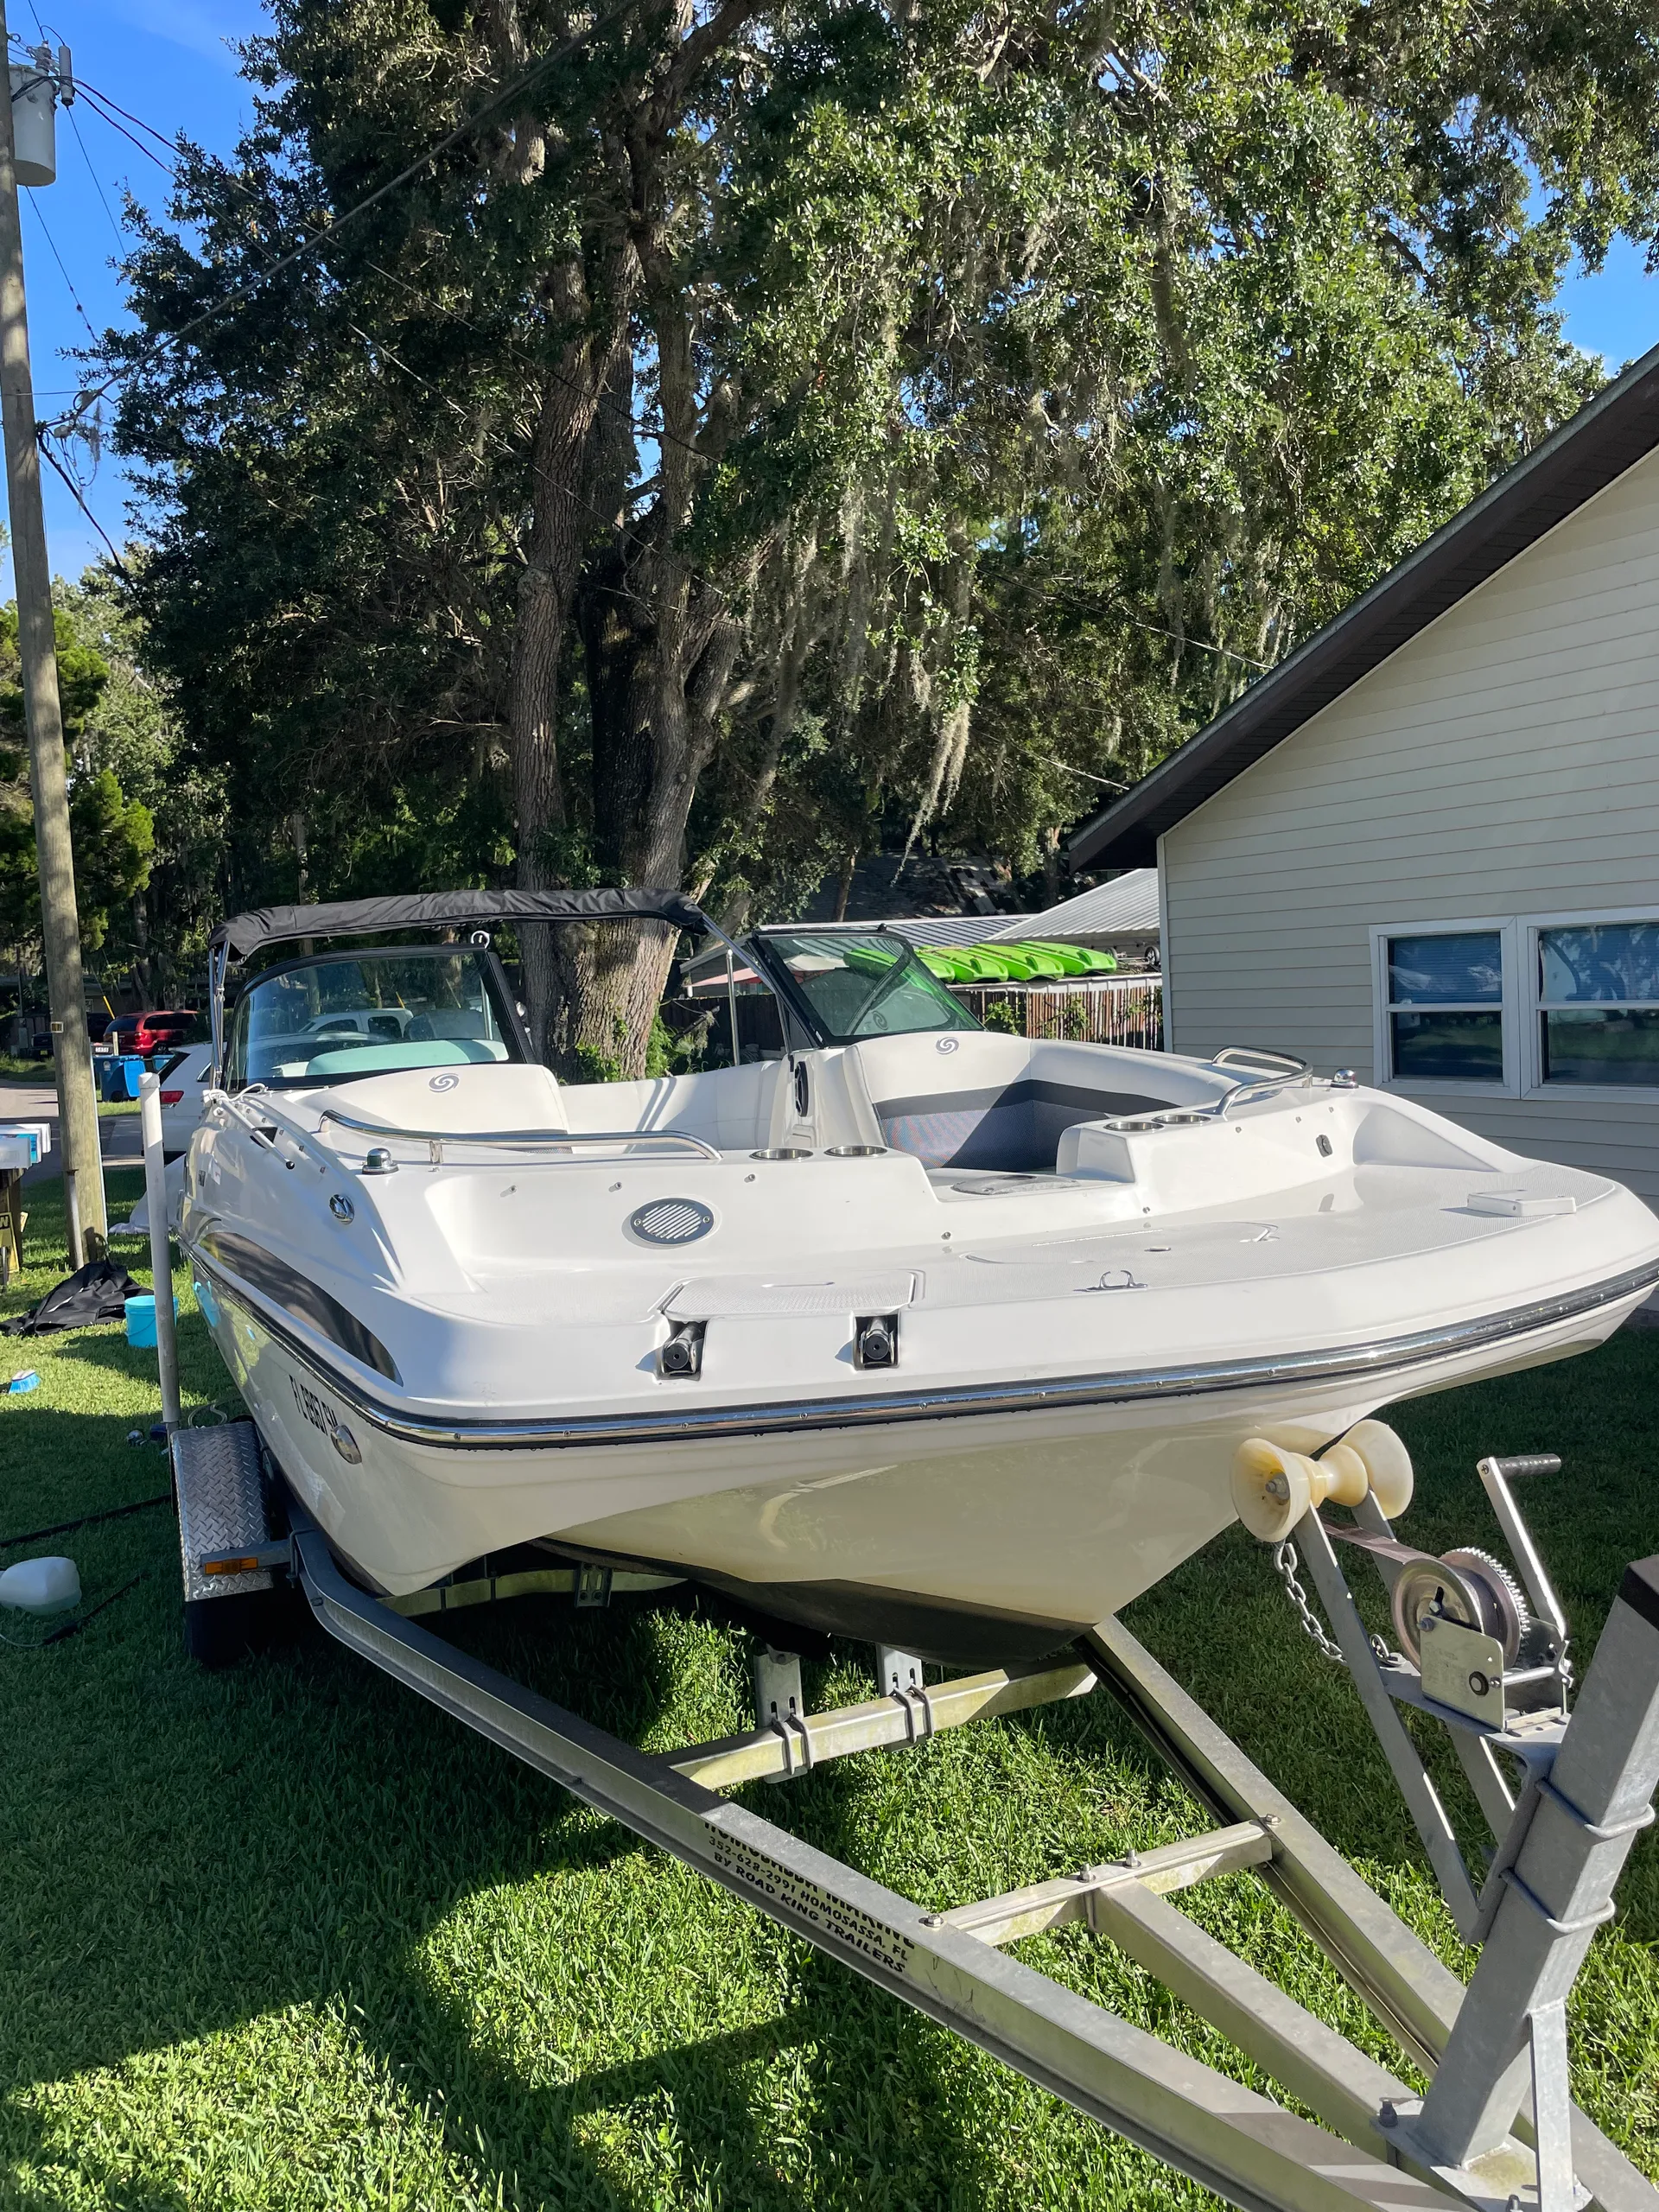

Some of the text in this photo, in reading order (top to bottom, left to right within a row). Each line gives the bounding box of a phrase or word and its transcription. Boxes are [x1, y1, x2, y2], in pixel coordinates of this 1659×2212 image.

[709, 1836, 796, 1893] 352-628-2991
[893, 1943, 907, 1961] FL
[714, 1852, 732, 1867] BY
[736, 1865, 776, 1894] ROAD
[780, 1892, 819, 1921] KING
[825, 1918, 906, 1974] TRAILERS
